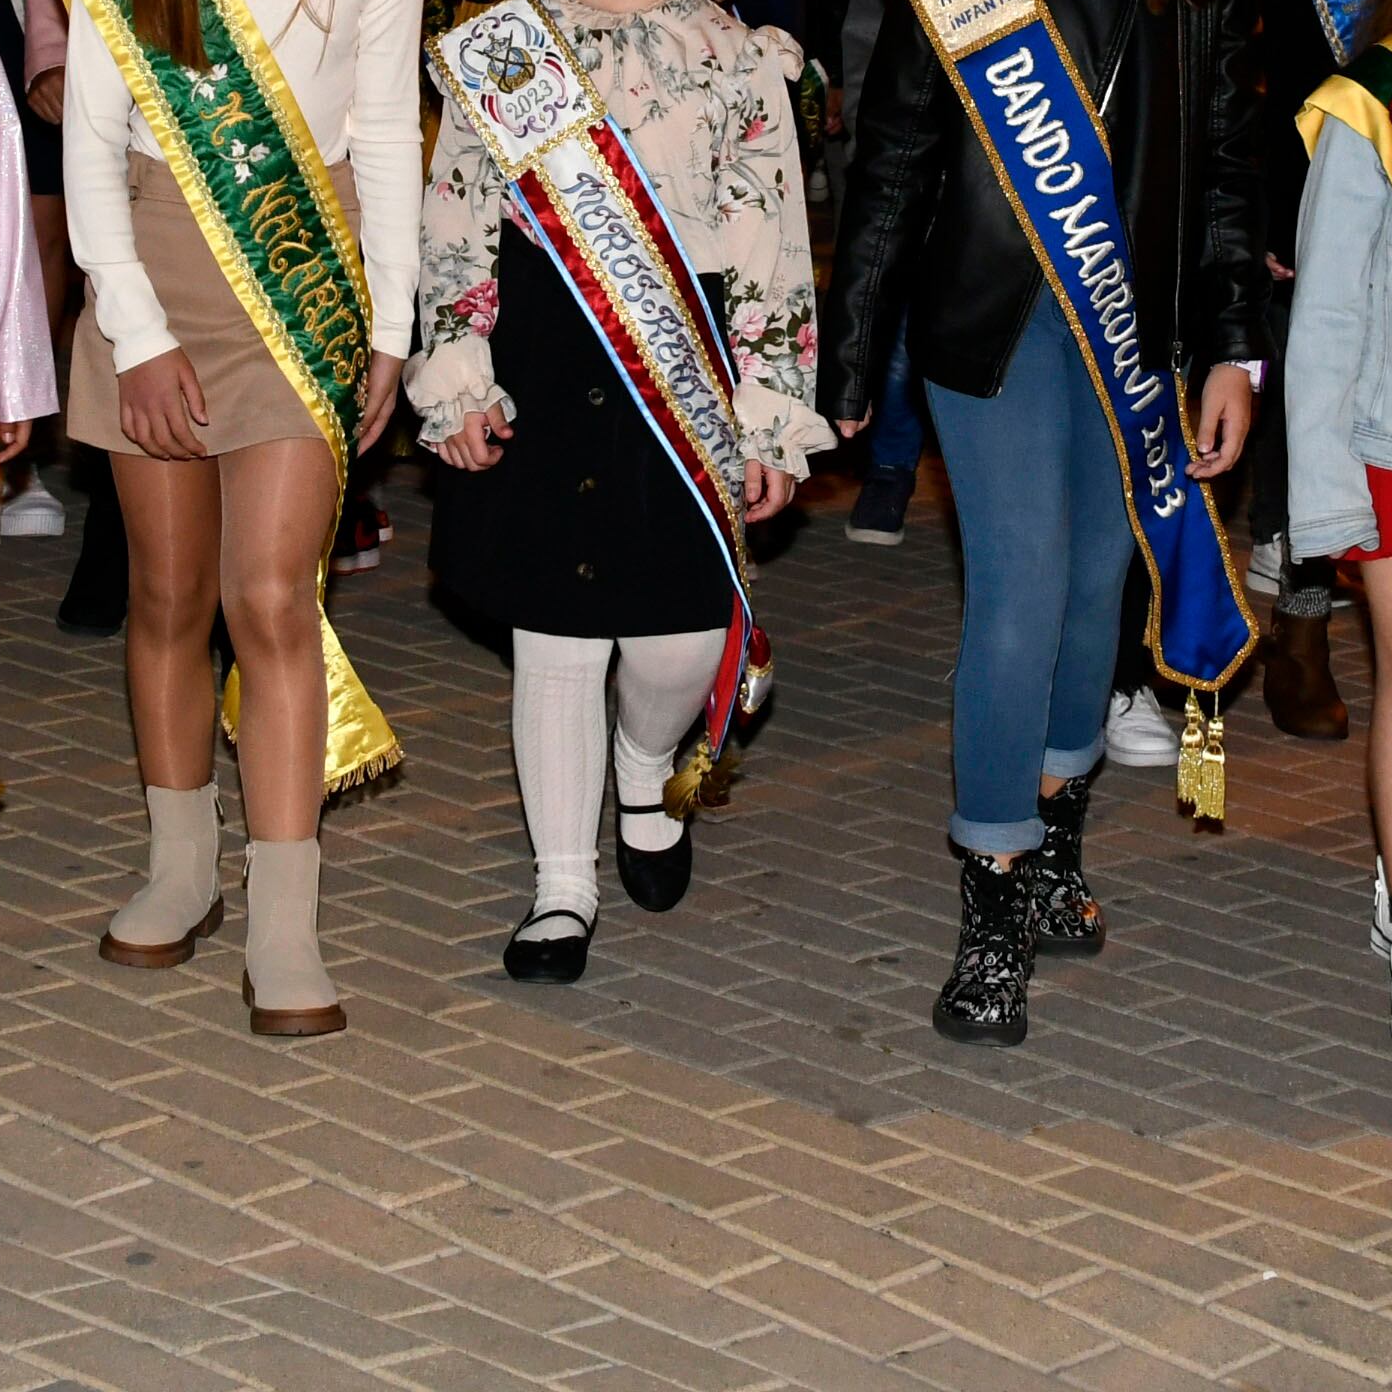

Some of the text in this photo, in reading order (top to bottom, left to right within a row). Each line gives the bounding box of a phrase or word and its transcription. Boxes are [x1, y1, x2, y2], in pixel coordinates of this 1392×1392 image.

[505, 79, 553, 120] 2023
[559, 172, 663, 302] MOROS
[984, 46, 1186, 519] BANDO MARROQUI 2023
